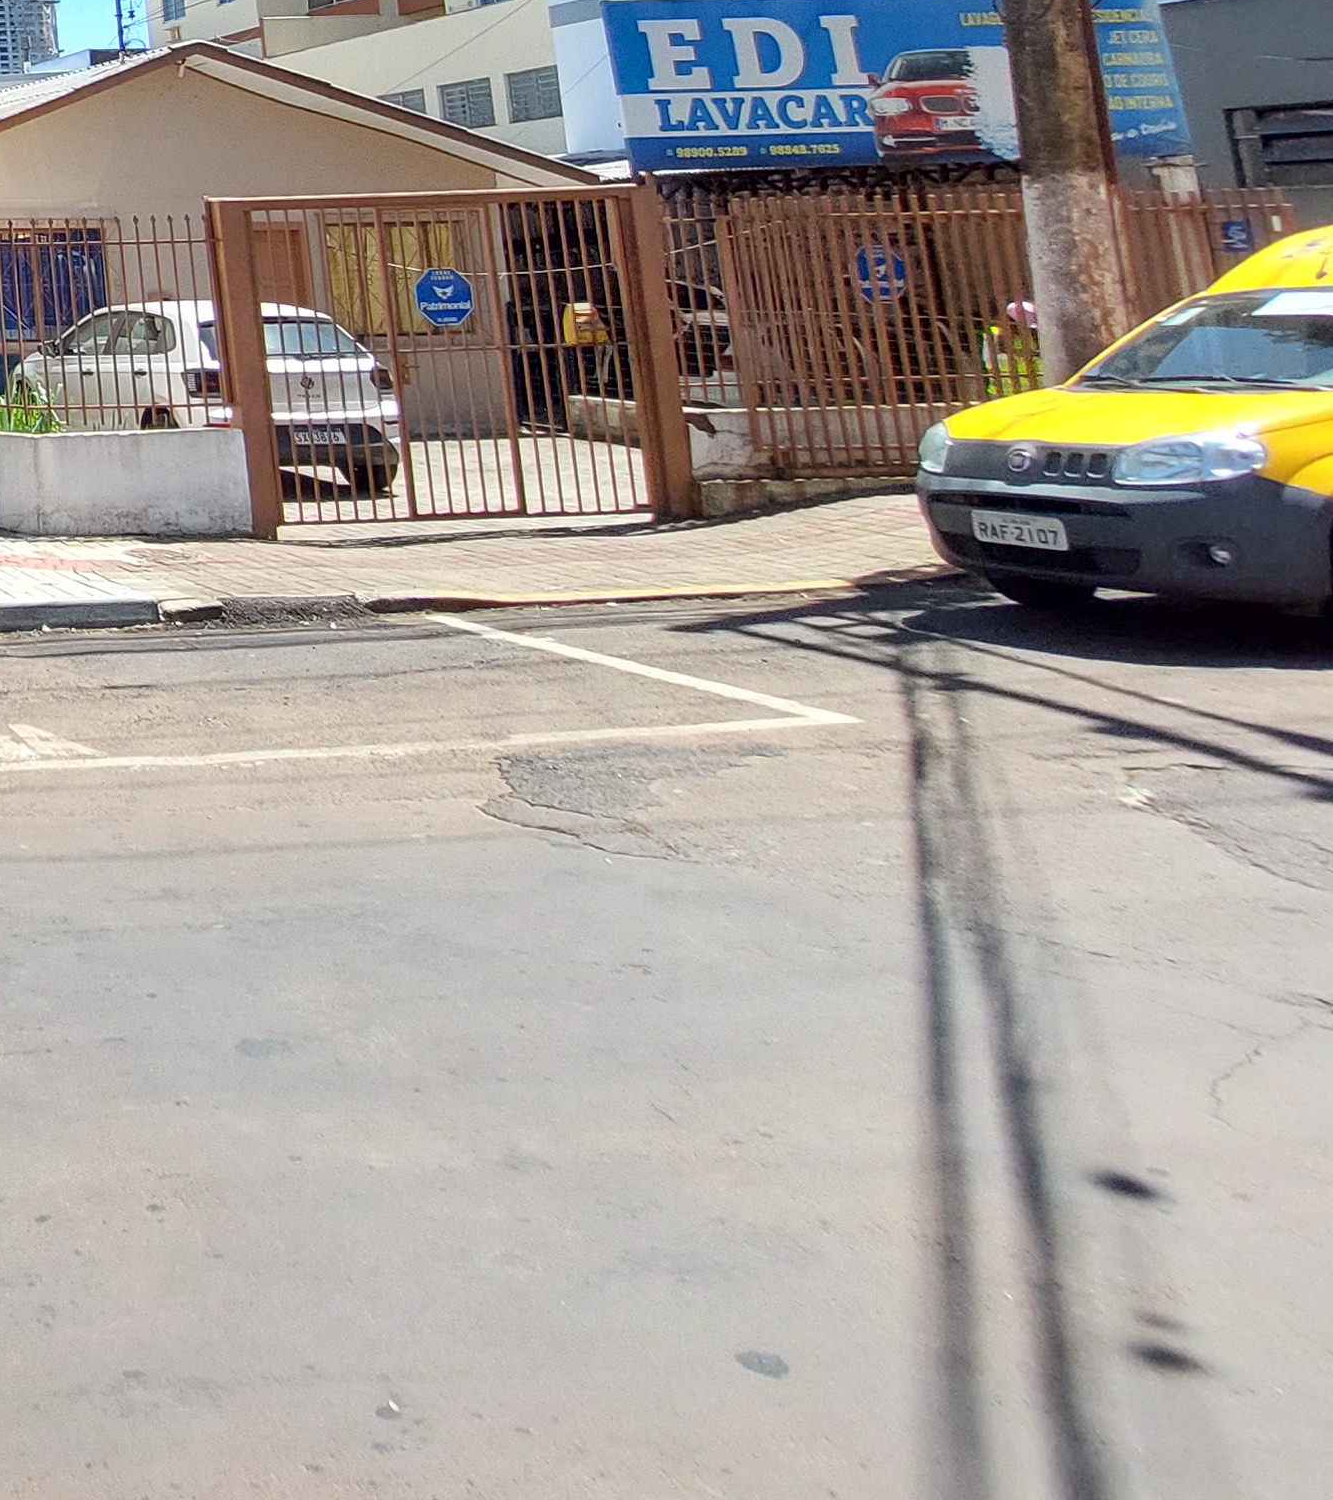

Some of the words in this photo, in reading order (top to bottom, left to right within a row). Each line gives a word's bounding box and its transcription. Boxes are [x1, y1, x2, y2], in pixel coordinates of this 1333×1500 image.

[636, 15, 870, 91] EDI
[654, 94, 874, 132] LAVACAR
[420, 300, 471, 310] Patrimonial
[978, 522, 1059, 546] RAF-2107
